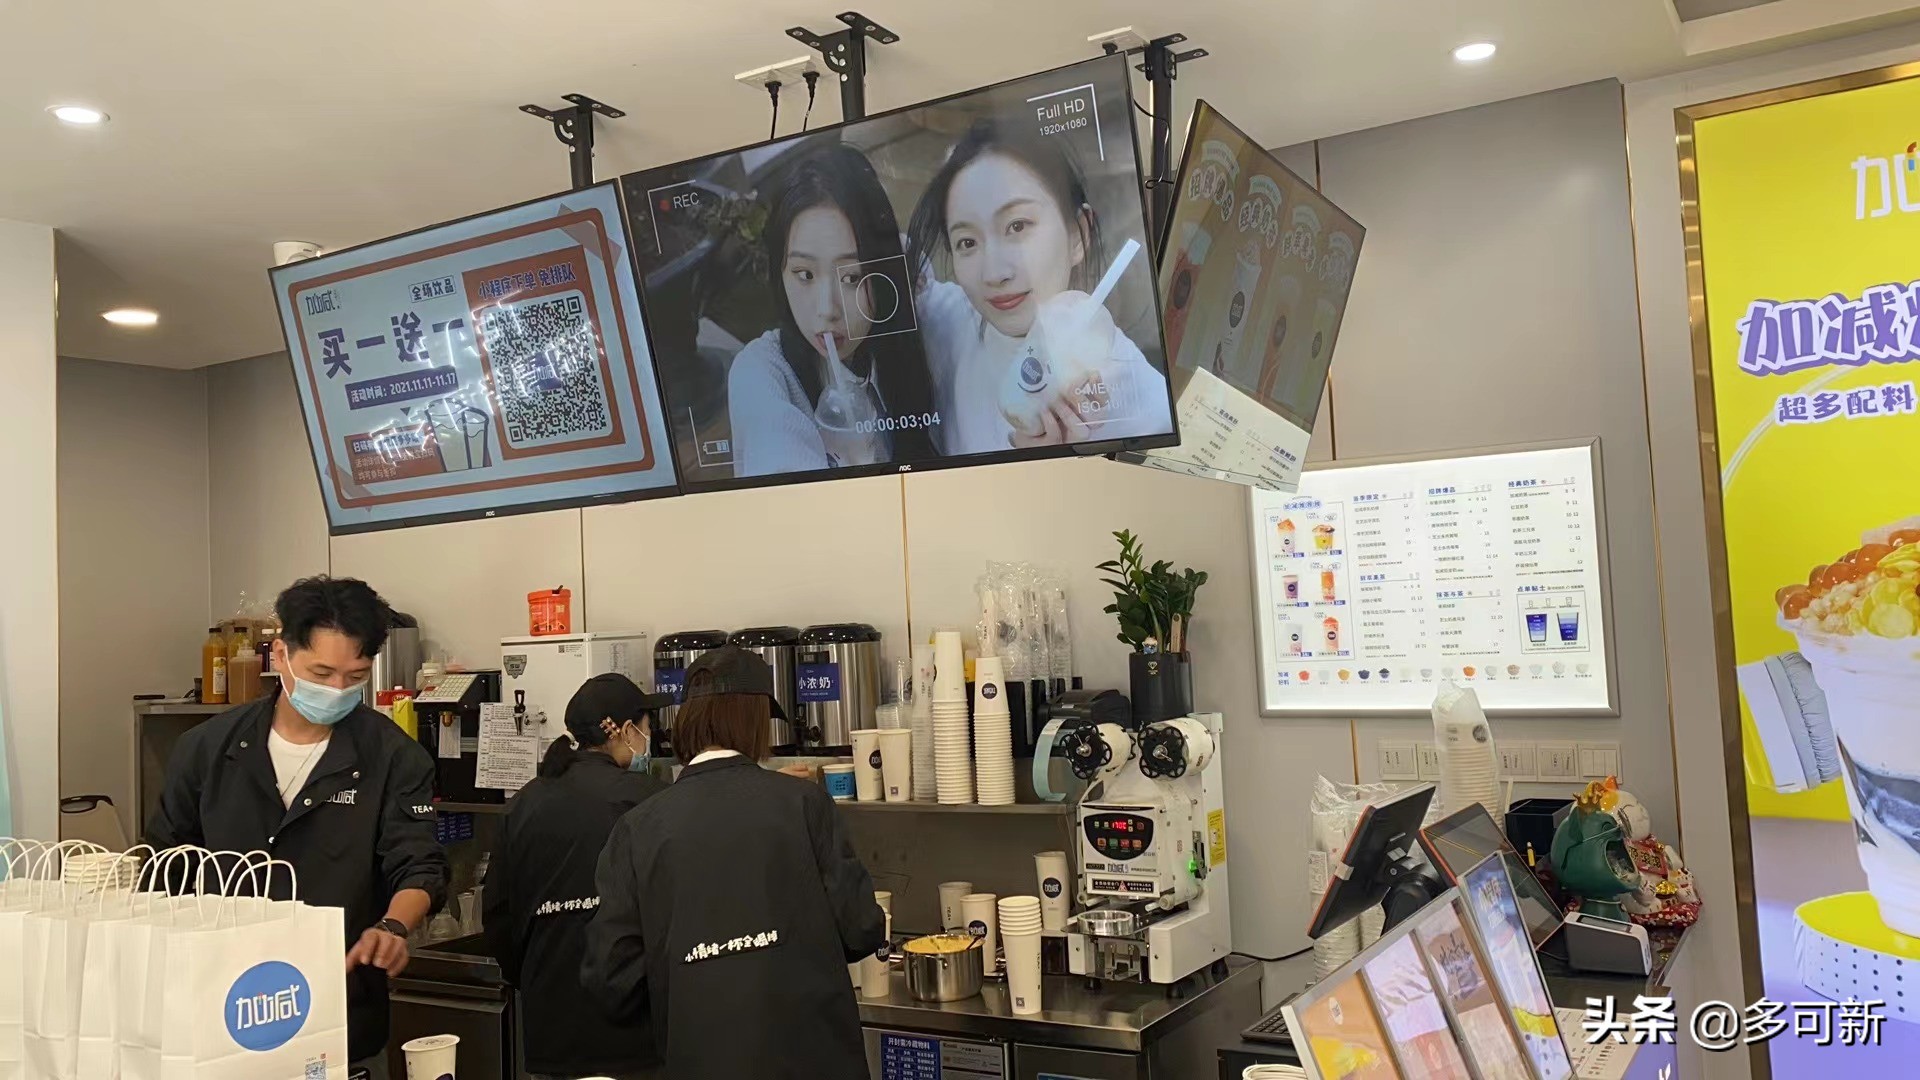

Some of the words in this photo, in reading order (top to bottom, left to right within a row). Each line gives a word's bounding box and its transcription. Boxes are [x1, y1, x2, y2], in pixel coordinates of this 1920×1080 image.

[1037, 104, 1060, 121] Full
[1064, 98, 1085, 115] HD
[1040, 117, 1087, 136] 1920x1080
[673, 192, 699, 208] REC
[412, 278, 455, 301] 全场饮品
[479, 272, 535, 299] 小程序下单
[538, 262, 576, 287] 免排队
[1739, 281, 1920, 371] 加减
[318, 311, 465, 379] 买一送一
[1077, 401, 1100, 414] ISO
[1778, 384, 1914, 422] 超多配料
[855, 411, 941, 434] 00:00:03;04
[684, 930, 778, 963] 小情绪一杯全喝掉
